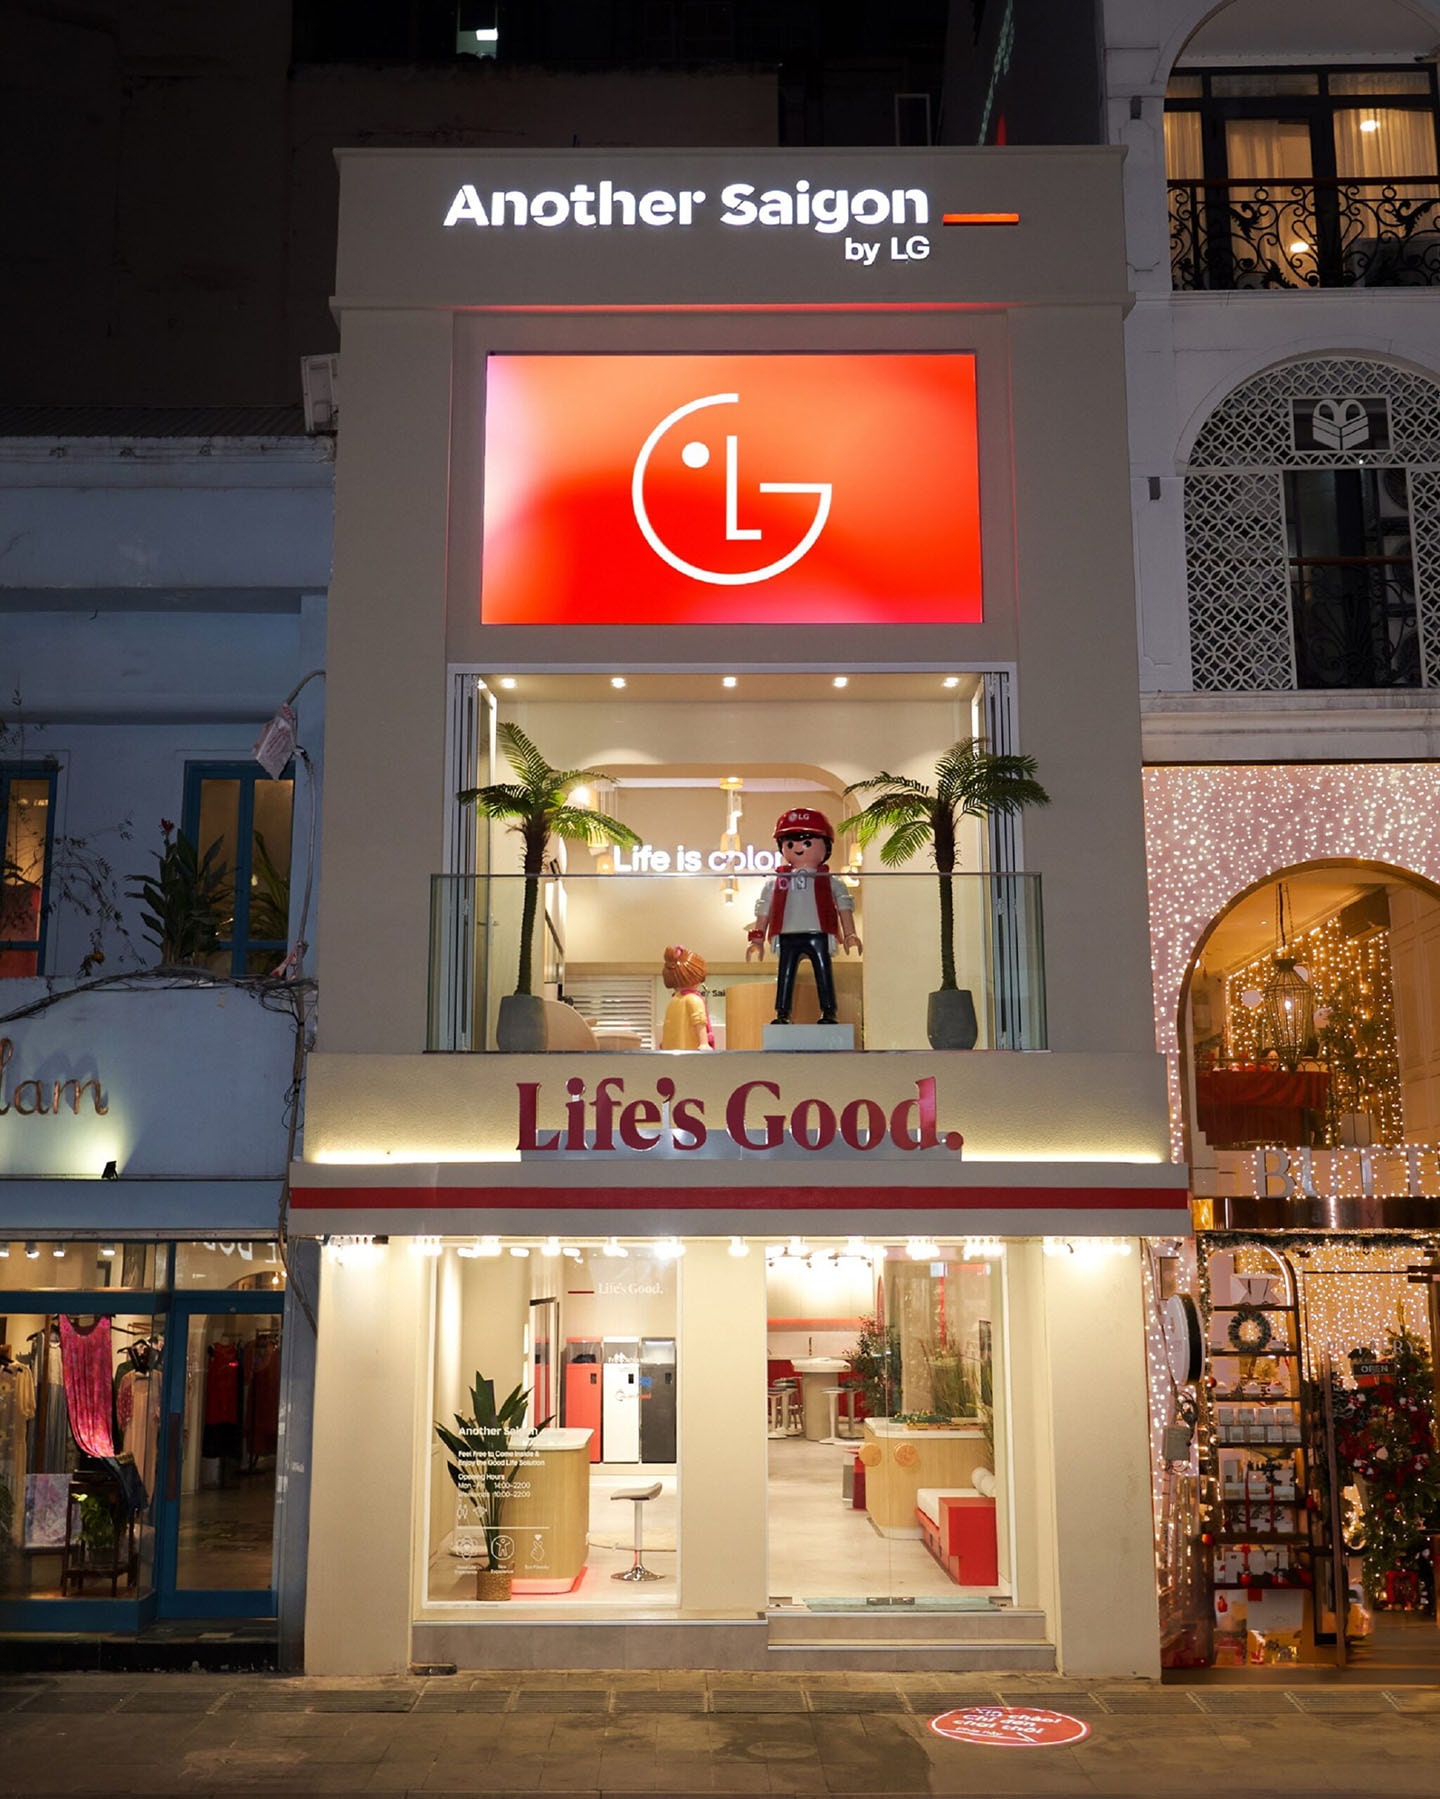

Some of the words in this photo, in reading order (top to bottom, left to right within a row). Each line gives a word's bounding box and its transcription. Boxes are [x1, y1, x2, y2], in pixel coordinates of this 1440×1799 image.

[443, 180, 706, 227] Another
[720, 180, 930, 233] Saigon
[845, 237, 880, 266] by
[891, 236, 930, 261] LG
[798, 813, 810, 821] LG
[613, 845, 672, 873] Life
[677, 845, 702, 872] is
[711, 989, 727, 998] Sai
[516, 1076, 708, 1152] Life's
[725, 1075, 964, 1152] Good.
[598, 1282, 626, 1295] Life's
[628, 1282, 664, 1295] Good.
[459, 1425, 502, 1436] Another
